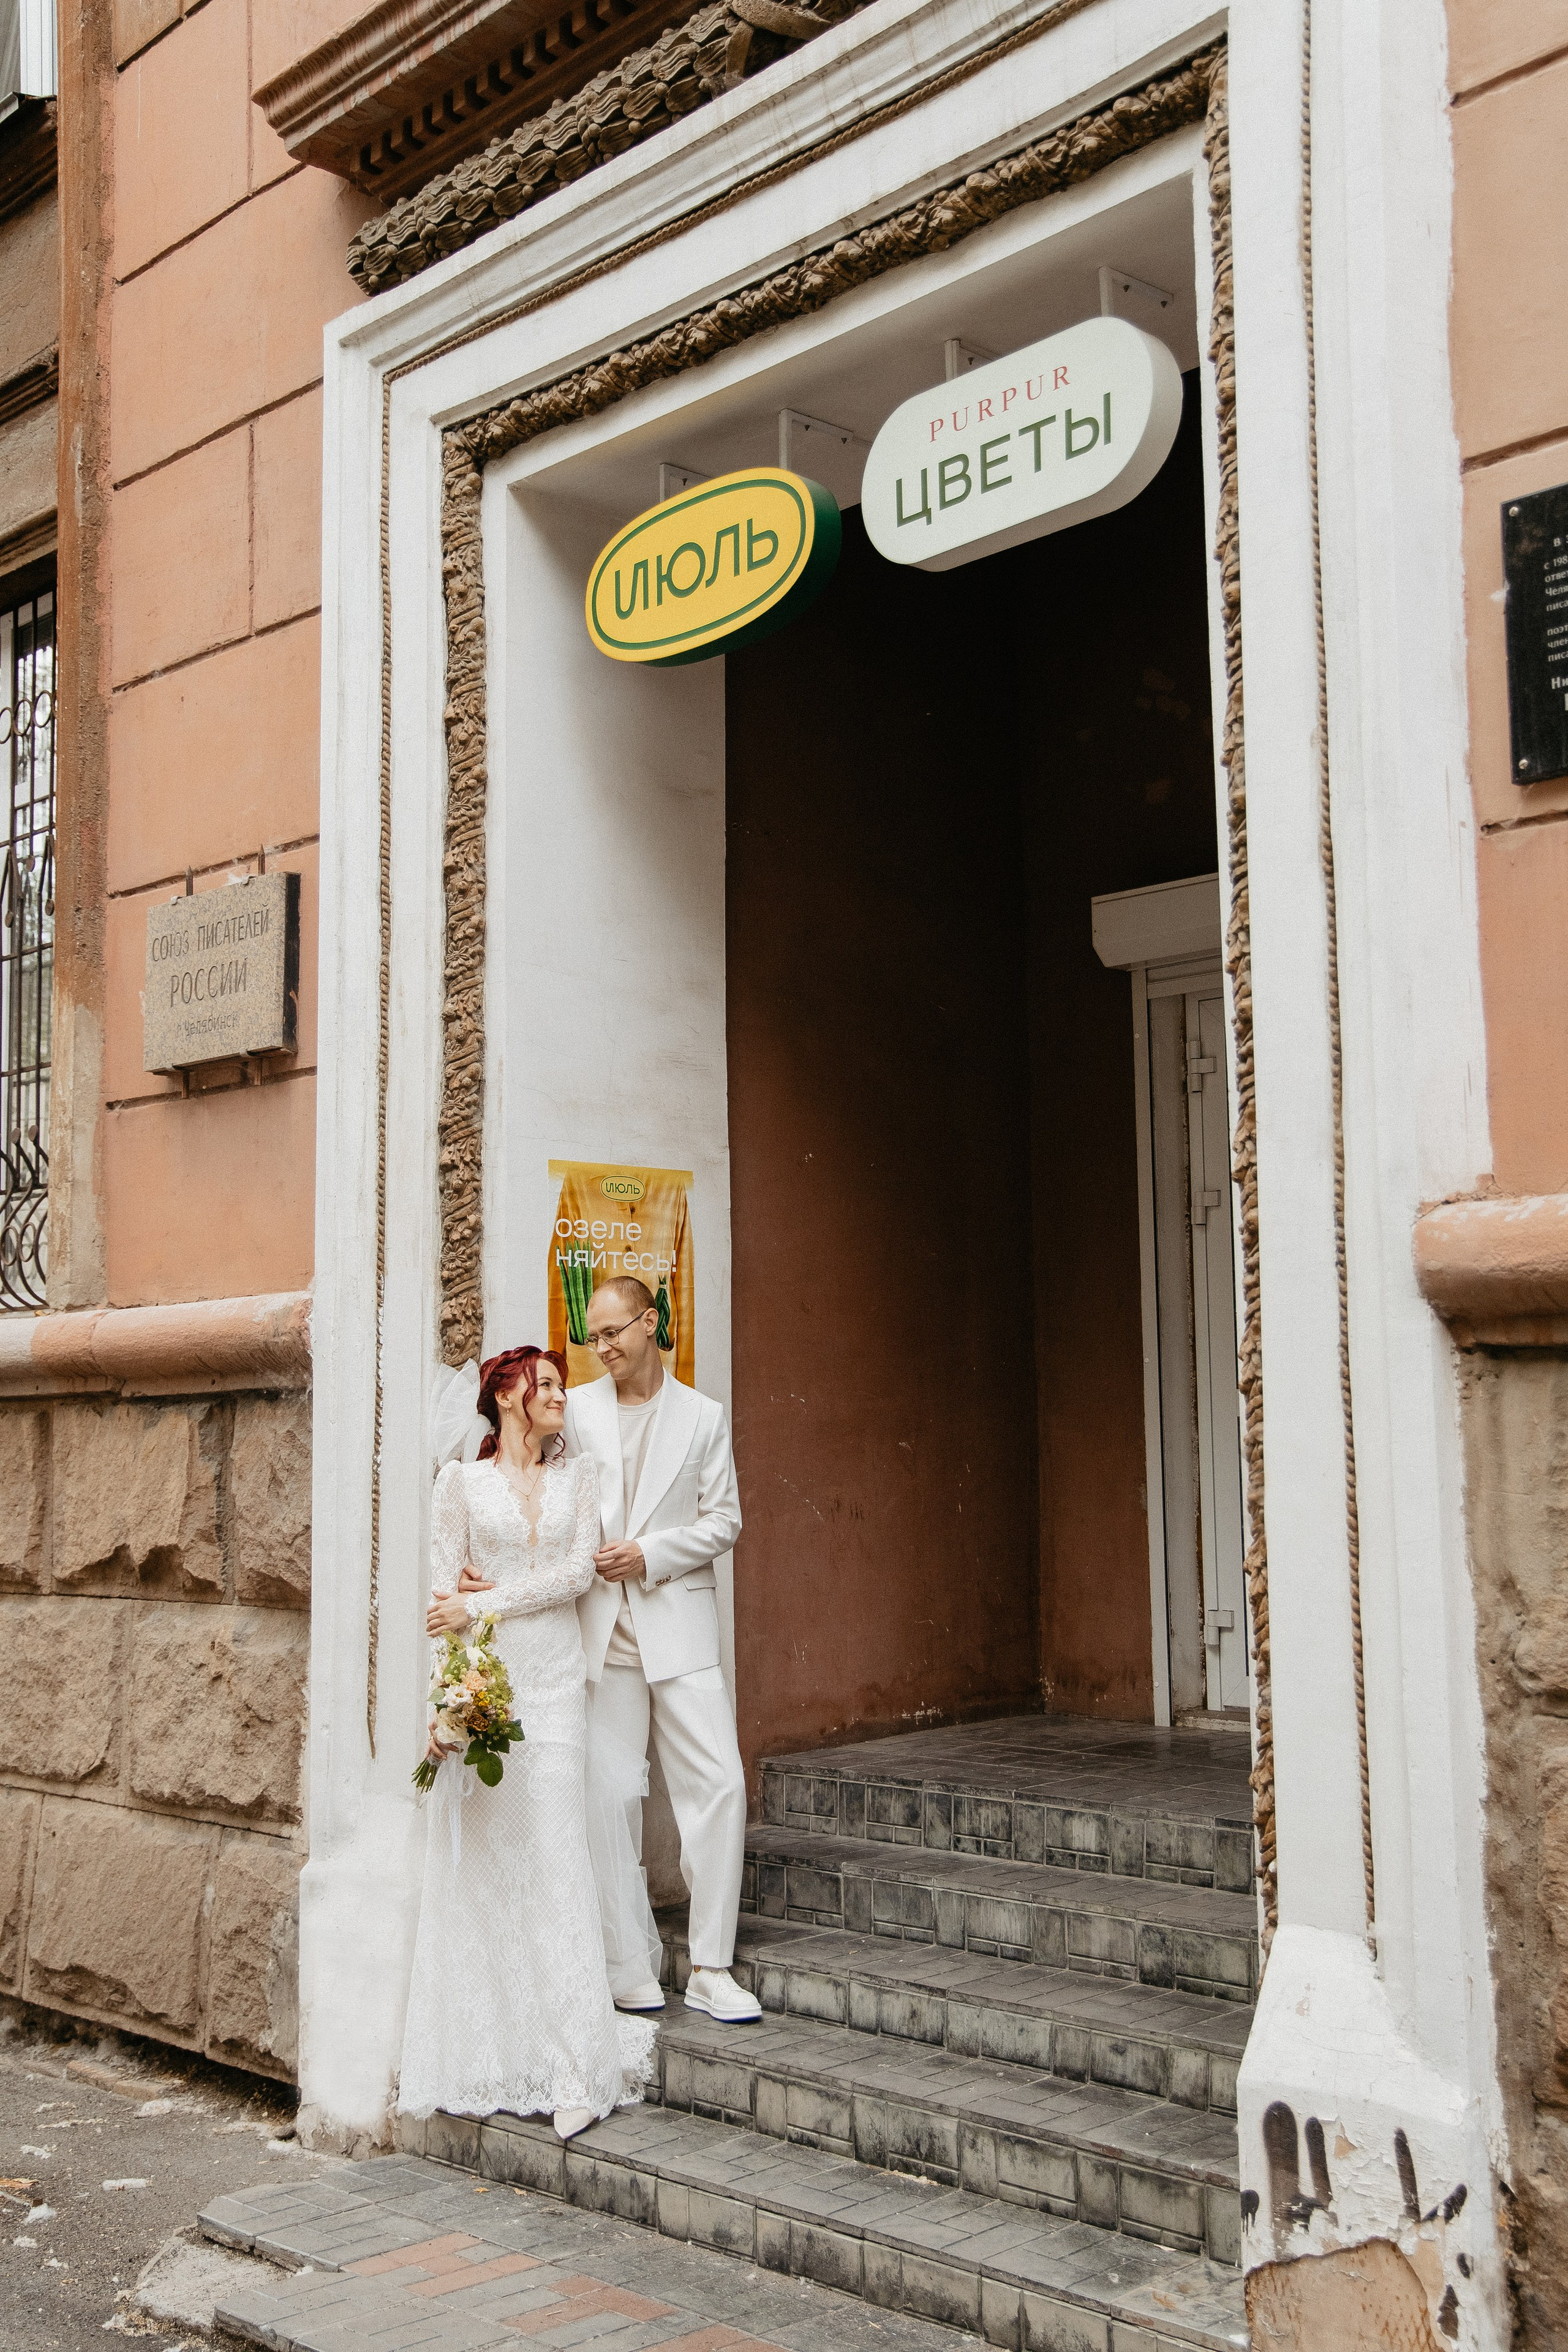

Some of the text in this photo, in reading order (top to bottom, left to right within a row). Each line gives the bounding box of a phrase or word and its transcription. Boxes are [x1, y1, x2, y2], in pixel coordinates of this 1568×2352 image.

[929, 366, 1071, 442] PURPUR
[895, 392, 1112, 527] ЦВЕТЫ
[614, 518, 779, 619] ИЮЛЬ
[152, 904, 269, 962] СОЮЗ ПИСАТЕЛЕЙ
[170, 958, 247, 1008] РОССИИ
[606, 1182, 640, 1194] ИЮЛЬ
[555, 1218, 641, 1241] озеле
[556, 1242, 676, 1272] няйтесь!
